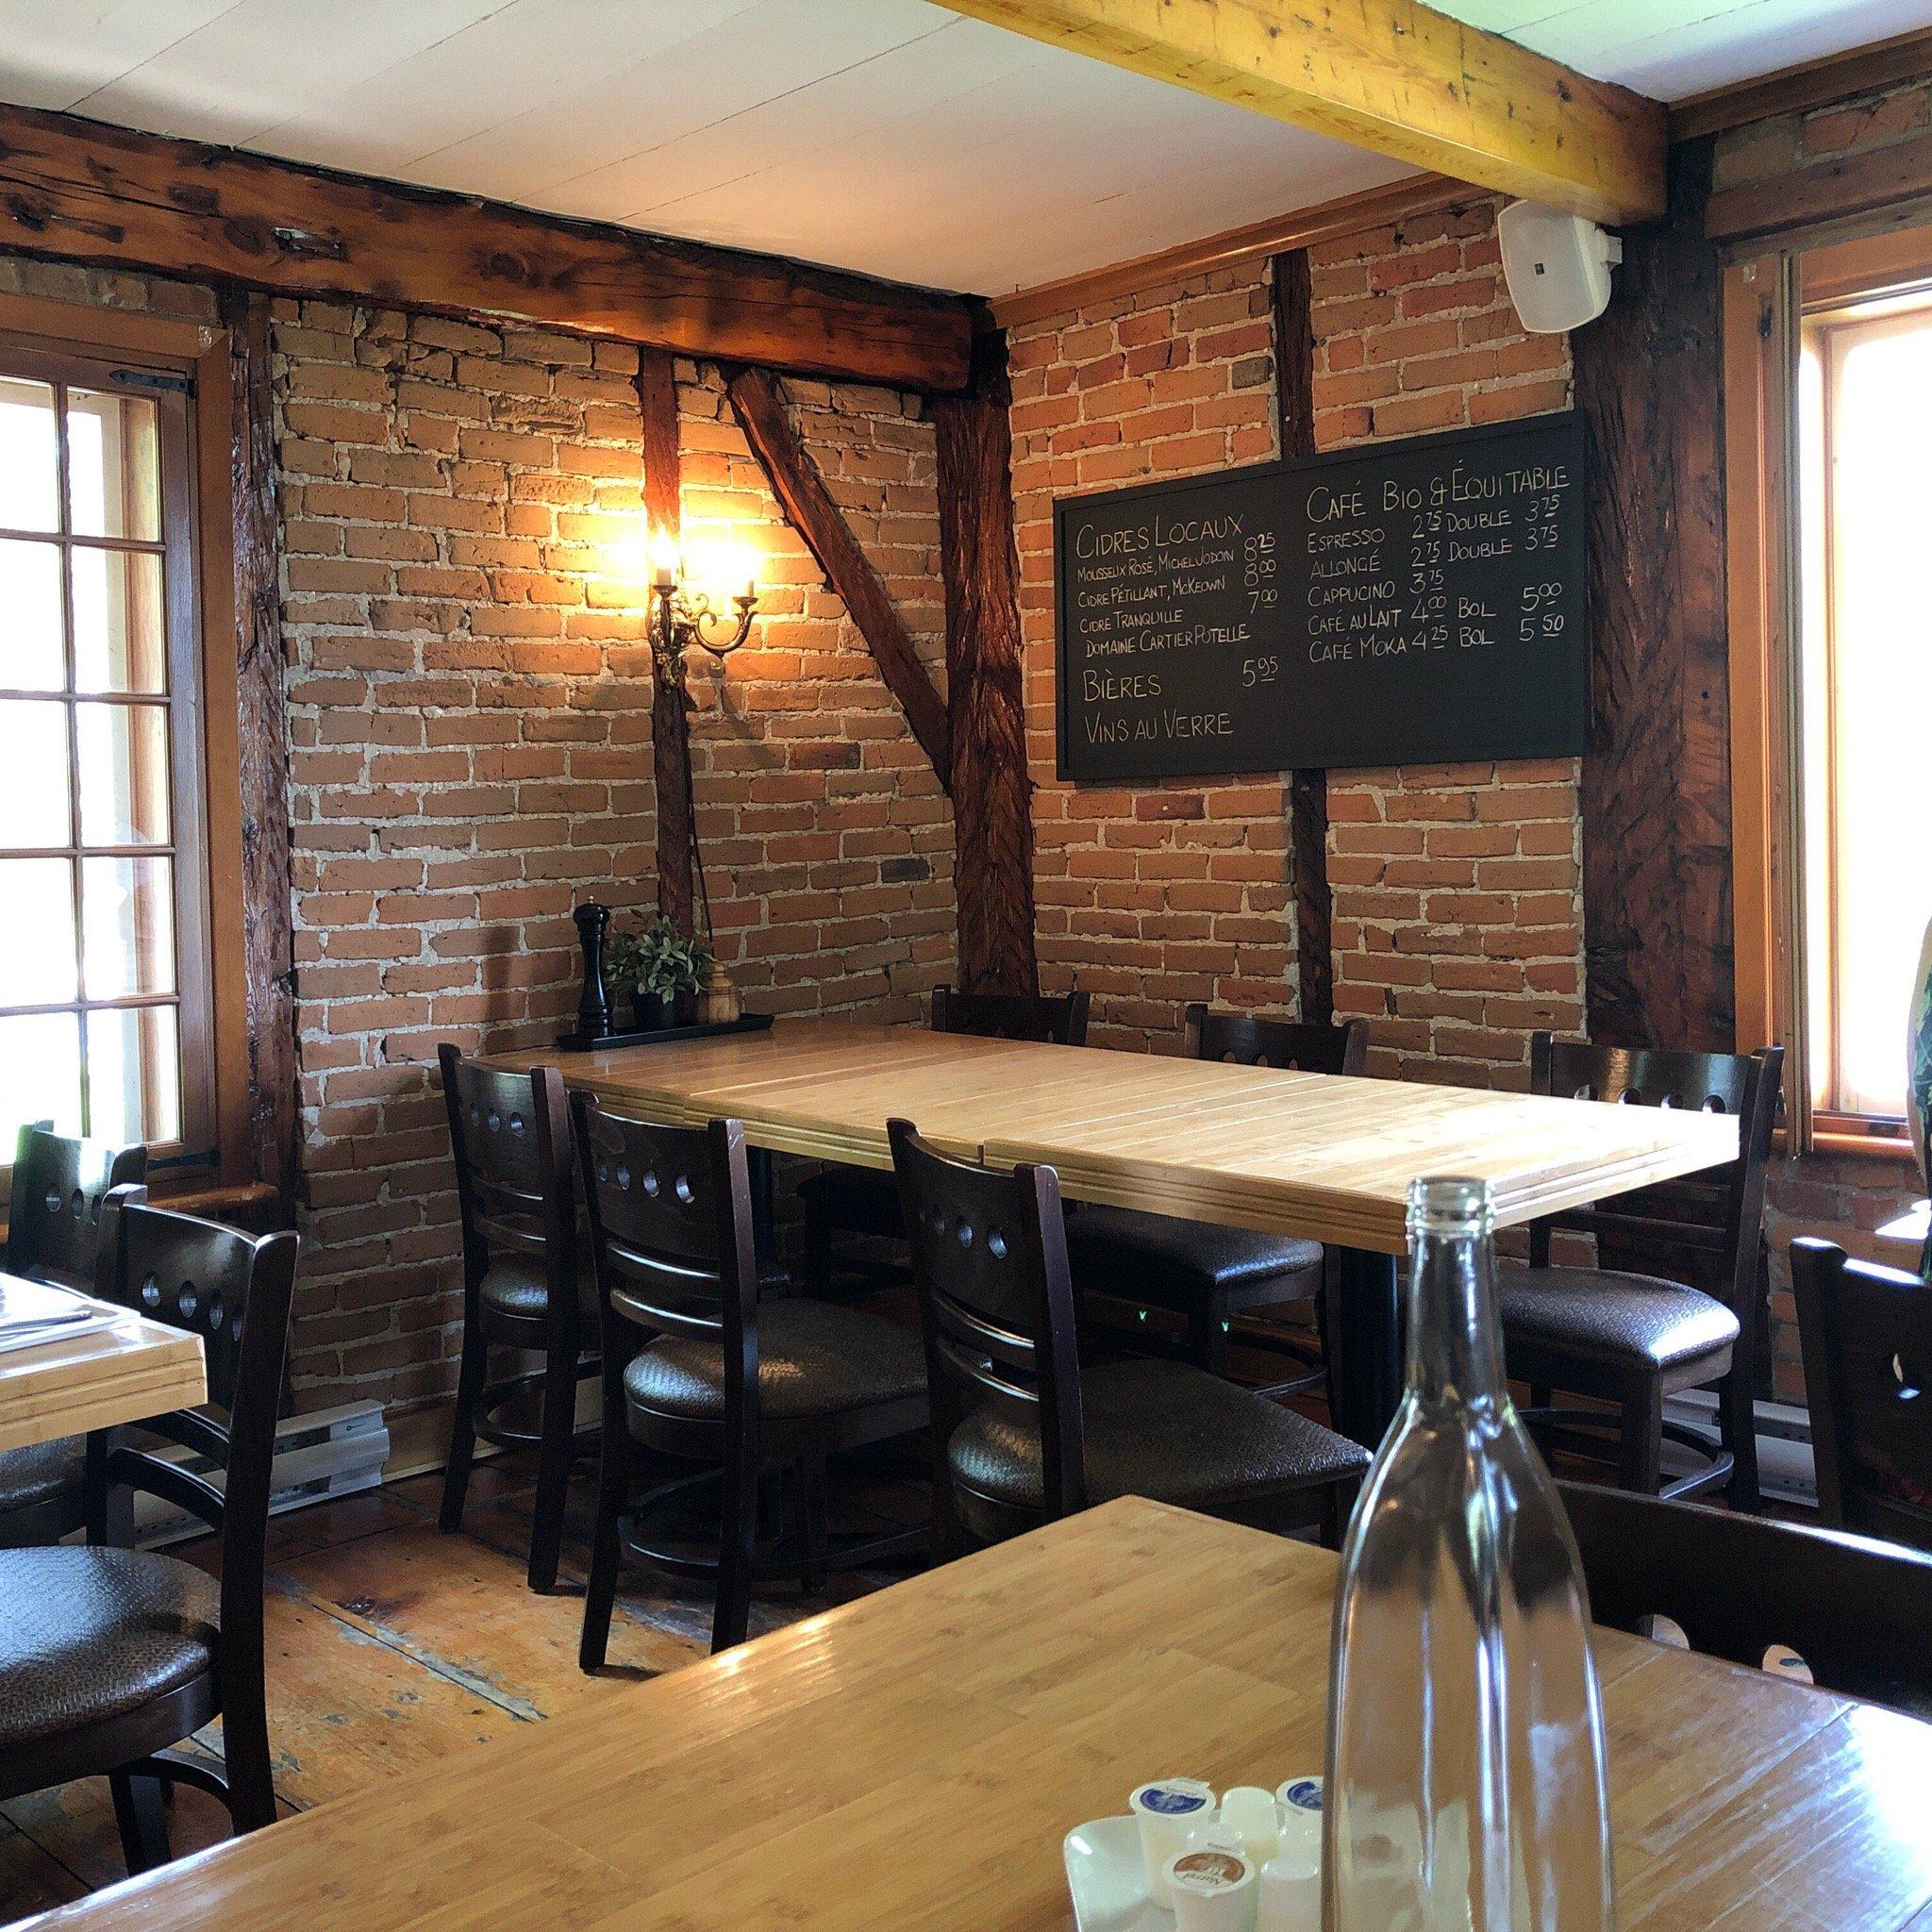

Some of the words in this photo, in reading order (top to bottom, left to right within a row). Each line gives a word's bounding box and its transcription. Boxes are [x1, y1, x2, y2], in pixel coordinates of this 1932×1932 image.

[1307, 479, 1366, 523] CAFÉ
[1383, 481, 1423, 511] BIO
[1076, 525, 1149, 558] CIDRES
[1156, 514, 1243, 546] LOCAUX
[1307, 528, 1385, 553] ESPRESSO
[1446, 510, 1511, 532] DOUBLE
[1447, 539, 1512, 562] DOUBLE
[1077, 566, 1125, 583] MOUSSEUX
[1077, 591, 1109, 608] CIDRE
[1308, 581, 1395, 606] CAPPUCINO
[1080, 618, 1111, 633] CIDRE
[1113, 609, 1183, 629] TRANQUILLE
[1308, 609, 1345, 635] CAFÉ
[1458, 597, 1496, 619] BOL
[1086, 637, 1136, 658] DOMAINE
[1140, 630, 1192, 652] CARTIER
[1309, 637, 1353, 662] CAFÉ
[1360, 633, 1407, 658] MOKA
[1458, 626, 1495, 647] BOL
[1083, 669, 1161, 701] BIÈRES
[1085, 711, 1129, 743] VINS
[1135, 718, 1158, 741] AU
[1163, 708, 1234, 739] VERRE
